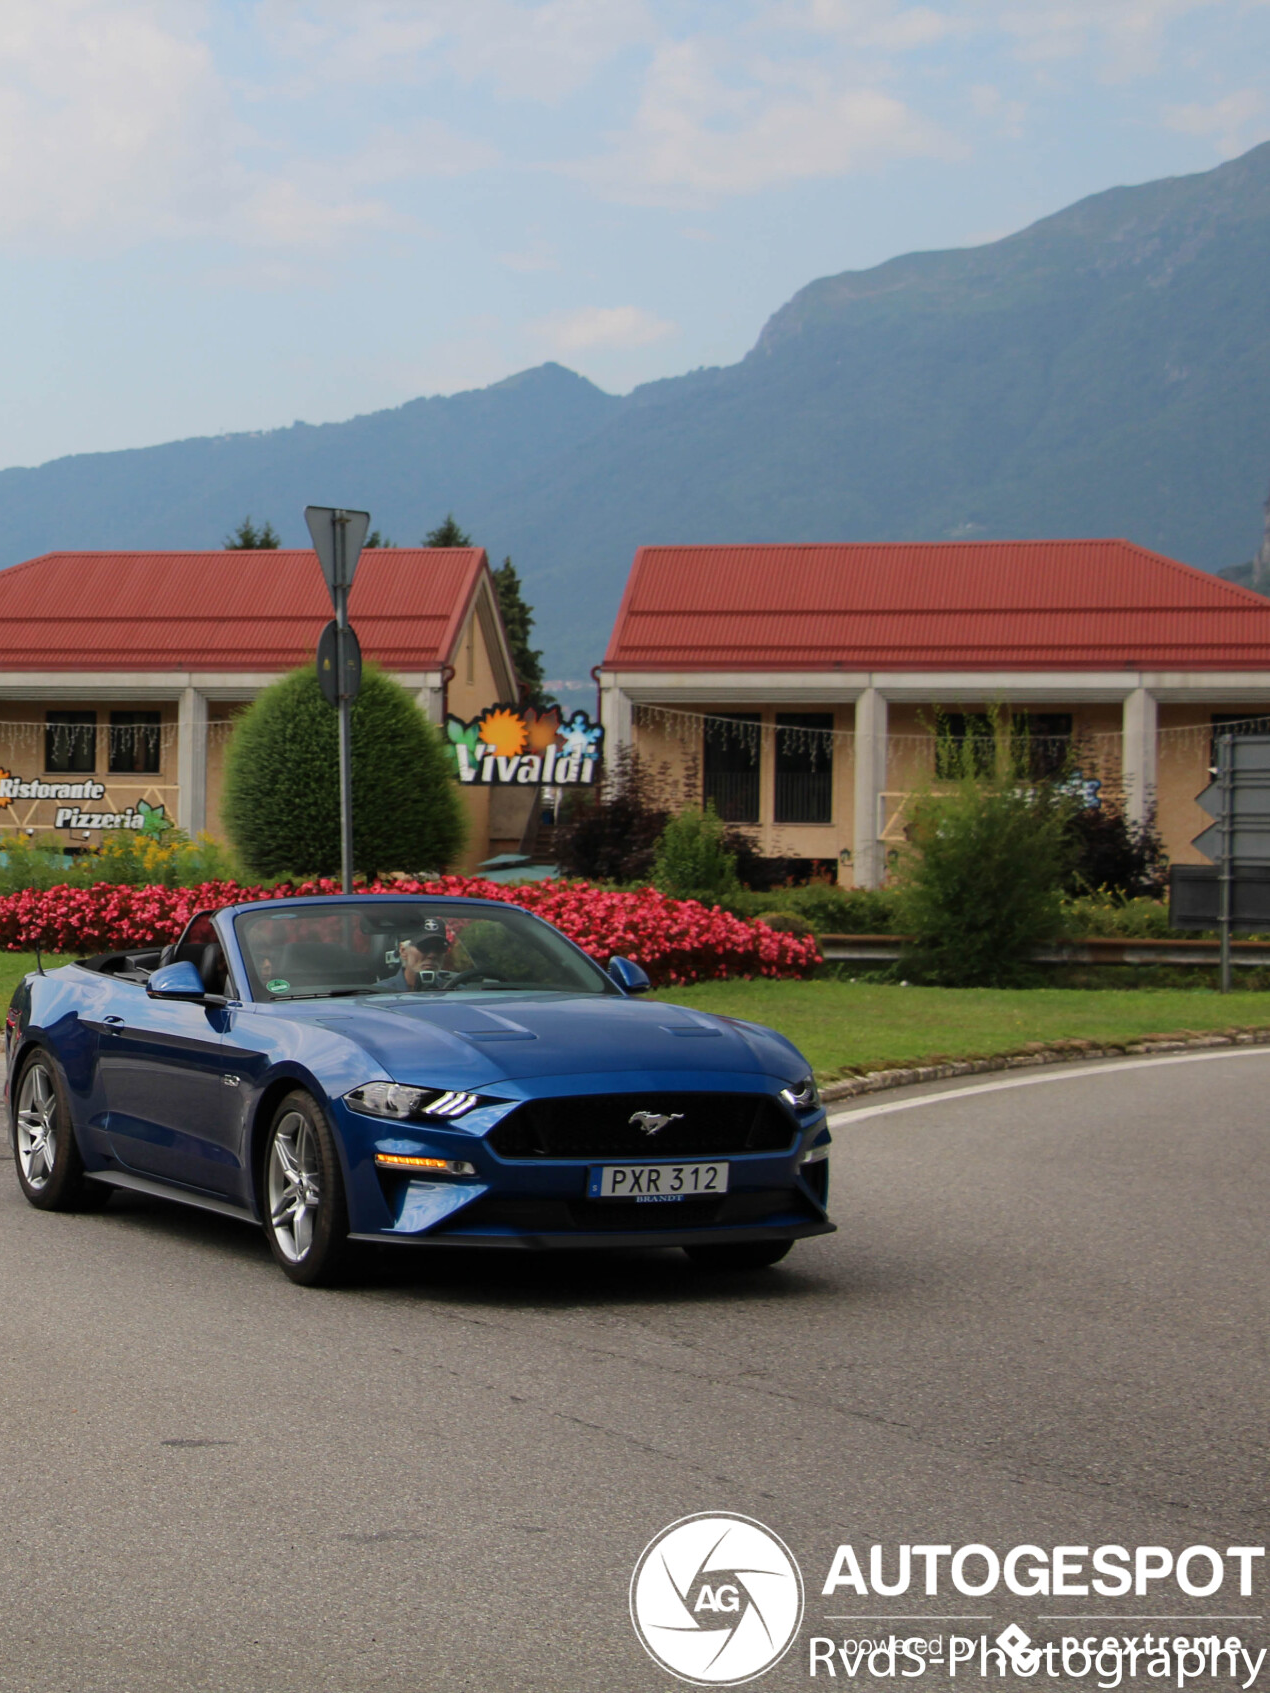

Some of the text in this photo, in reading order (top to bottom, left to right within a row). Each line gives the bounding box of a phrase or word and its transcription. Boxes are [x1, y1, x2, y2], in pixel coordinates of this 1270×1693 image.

[455, 743, 596, 784] Vivaldi
[55, 807, 146, 829] Pizzeria
[611, 1169, 661, 1193] PXR
[670, 1166, 719, 1191] 312
[636, 1194, 684, 1203] BRANDT
